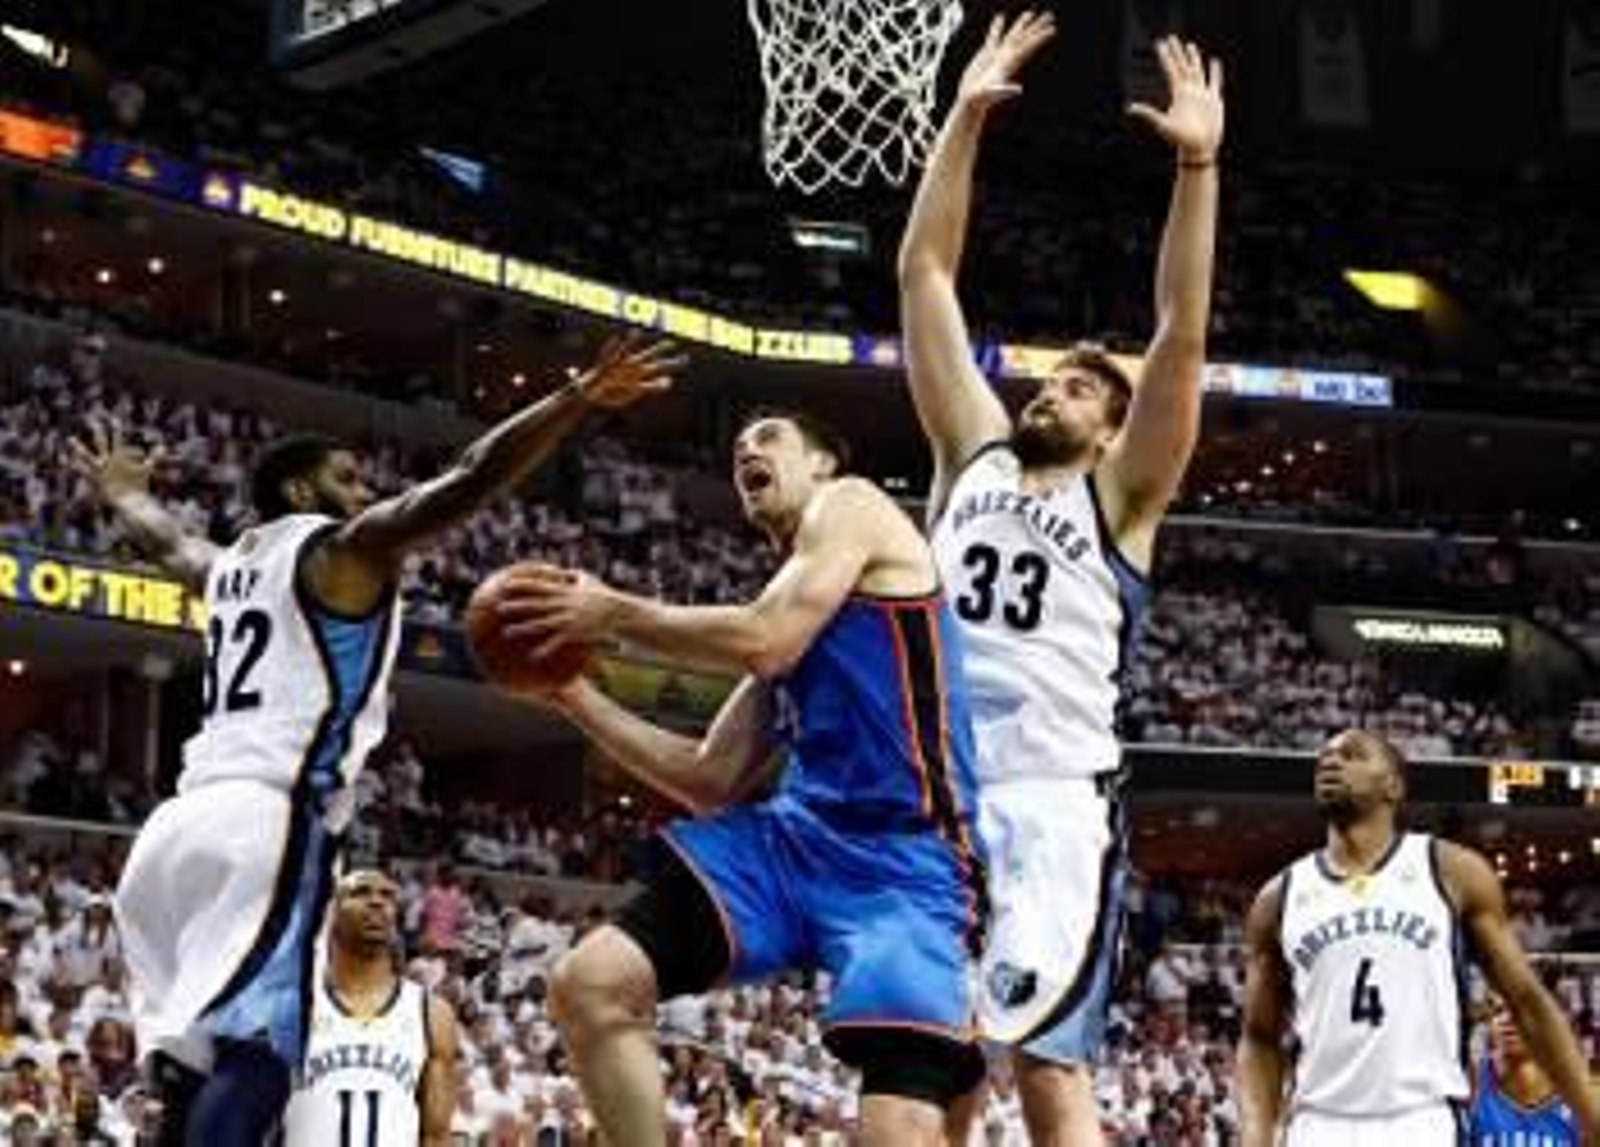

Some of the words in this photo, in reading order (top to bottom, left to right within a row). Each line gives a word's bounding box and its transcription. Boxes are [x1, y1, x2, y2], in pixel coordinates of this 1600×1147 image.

[240, 183, 346, 238] PROUD
[953, 491, 1092, 562] GRIZZLIES
[30, 561, 99, 609] OF
[102, 573, 183, 627] THE
[956, 542, 1051, 632] 33
[1293, 907, 1439, 973] GRIZZLIES
[1350, 957, 1385, 1028] 4
[337, 1090, 382, 1147] 11
